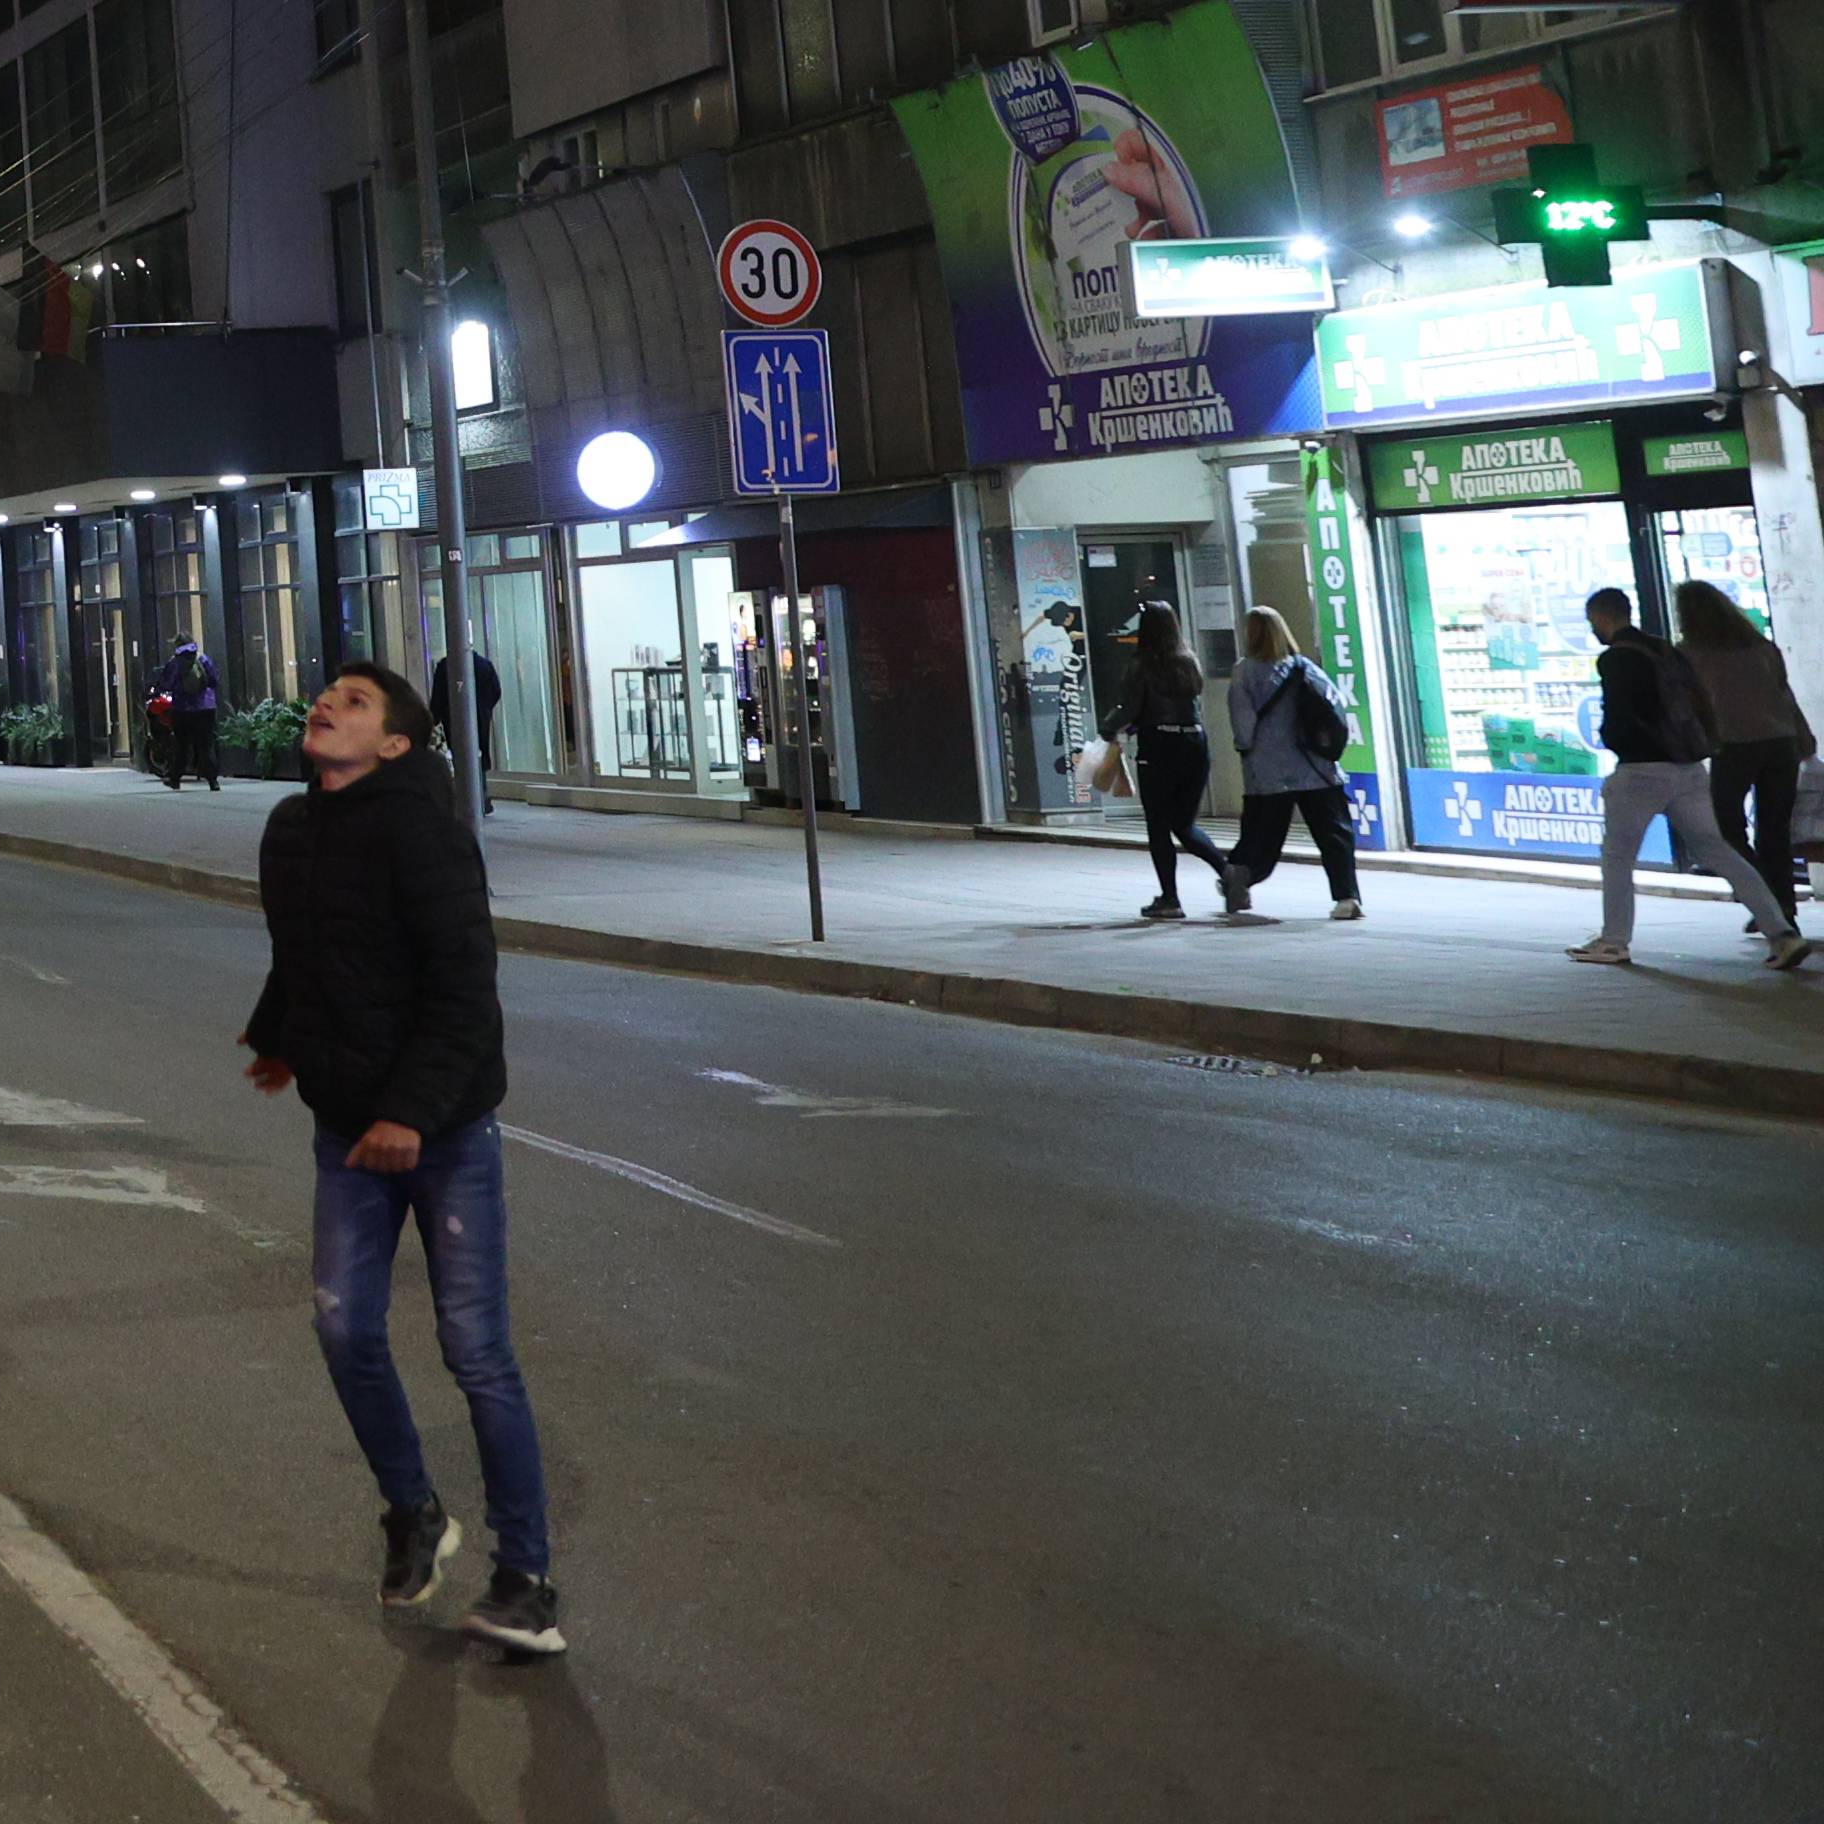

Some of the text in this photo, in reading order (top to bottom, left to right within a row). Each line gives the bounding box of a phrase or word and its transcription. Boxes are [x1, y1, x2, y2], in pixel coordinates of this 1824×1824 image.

[1006, 87, 1063, 120] ПОПУСТА
[740, 246, 799, 300] 30
[1072, 265, 1119, 300] ПОП
[1069, 310, 1122, 340] КАРТИЦУ
[1418, 301, 1575, 360] АПОТЕКА
[1100, 364, 1215, 409] АПОТЕКА
[1400, 333, 1600, 410] Кршенковић
[1087, 392, 1234, 453] Кршенковић
[1461, 436, 1567, 471] АПОТЕКА
[1669, 440, 1724, 456] АПОТЕКА
[367, 472, 411, 483] PRIZMA
[1449, 458, 1583, 504] Кршенковић
[1315, 477, 1366, 746] АПОТЕКА
[1059, 651, 1087, 754] Original
[1002, 710, 1018, 804] CIPELA
